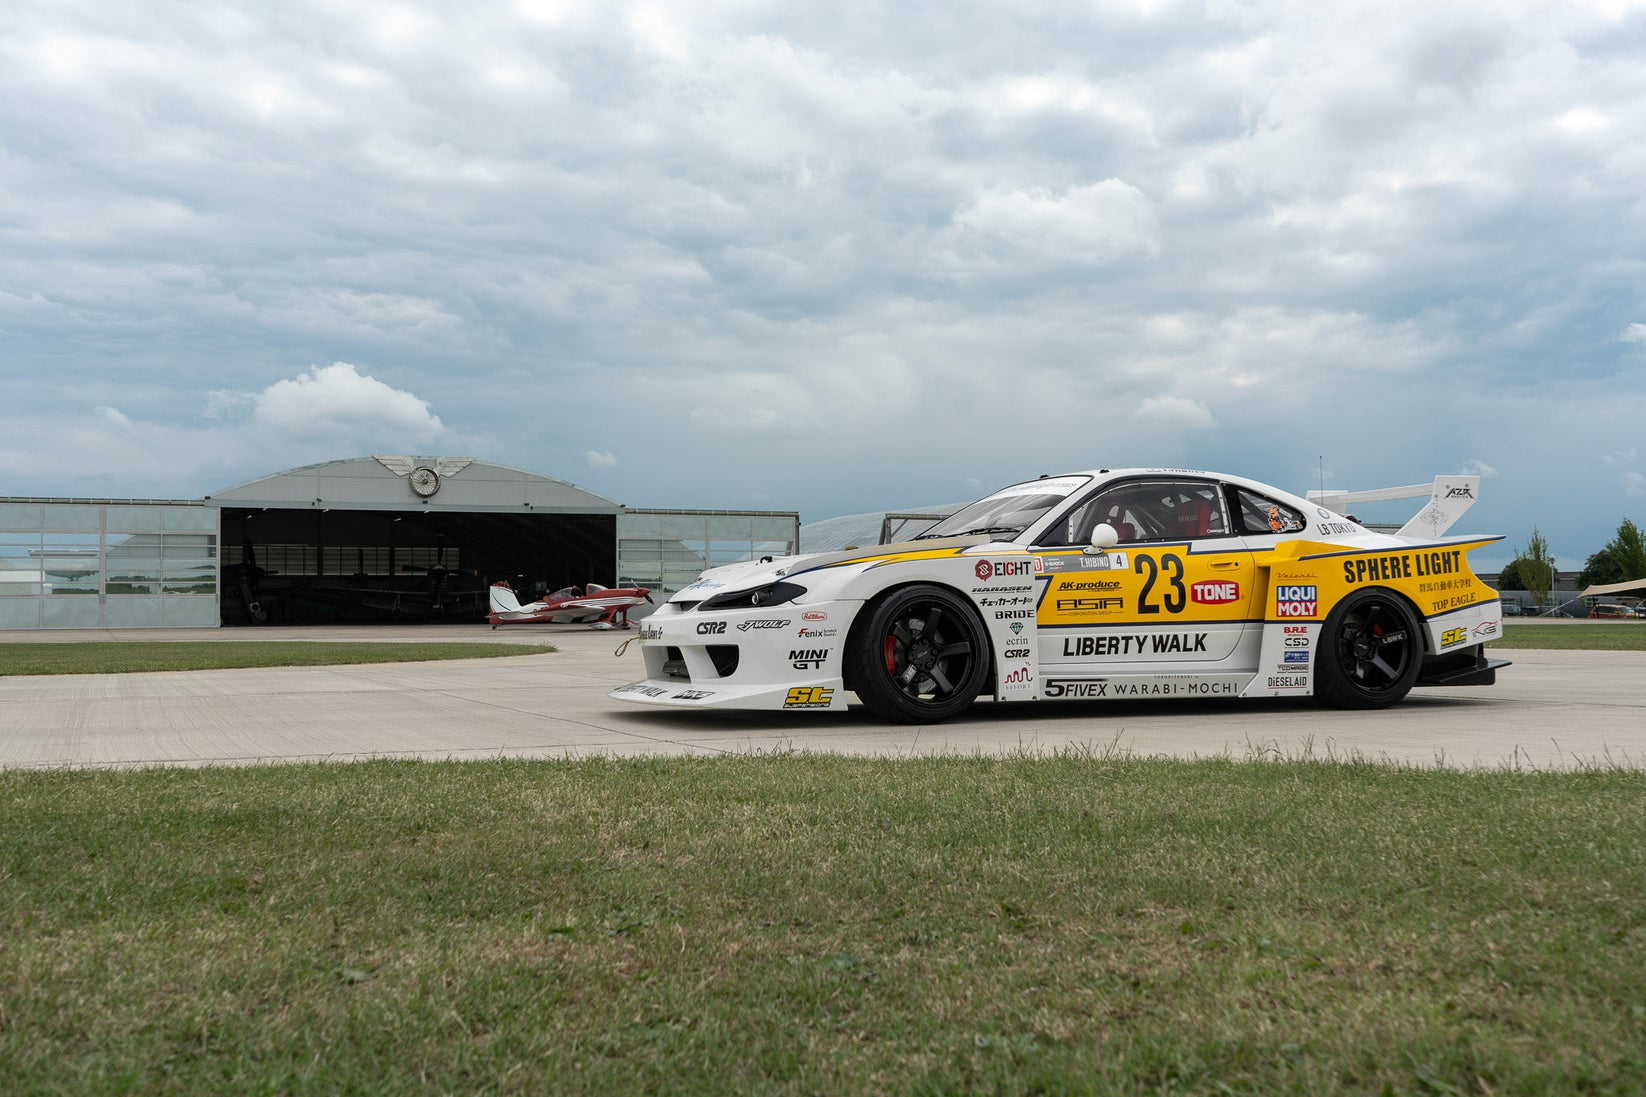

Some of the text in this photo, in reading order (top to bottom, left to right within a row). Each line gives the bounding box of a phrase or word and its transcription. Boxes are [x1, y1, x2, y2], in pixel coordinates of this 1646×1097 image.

[1316, 523, 1356, 535] LB TOKYO
[1080, 557, 1109, 568] T.HIBINO
[1116, 554, 1123, 567] 4
[1344, 550, 1460, 583] SPHERE LIGHT
[994, 561, 1031, 576] EIGHT
[1059, 580, 1120, 590] AK-produce
[1134, 553, 1186, 614] 23
[1193, 585, 1236, 600] TONE
[1278, 587, 1315, 600] LIQUI
[1057, 598, 1123, 611] ASIA
[1432, 592, 1476, 611] TOP EAGLE
[994, 610, 1035, 619] BRIDE
[1278, 602, 1316, 616] MOLY
[696, 621, 727, 635] CSR2
[797, 628, 823, 638] Fenix
[1006, 636, 1029, 646] ecrin
[1063, 633, 1208, 657] LIBERTY WALK
[1284, 638, 1309, 646] CSD
[788, 648, 829, 660] MINI
[1004, 649, 1030, 659] CSR2
[793, 659, 826, 670] GT
[1114, 682, 1238, 695] WARABI-MOCHI
